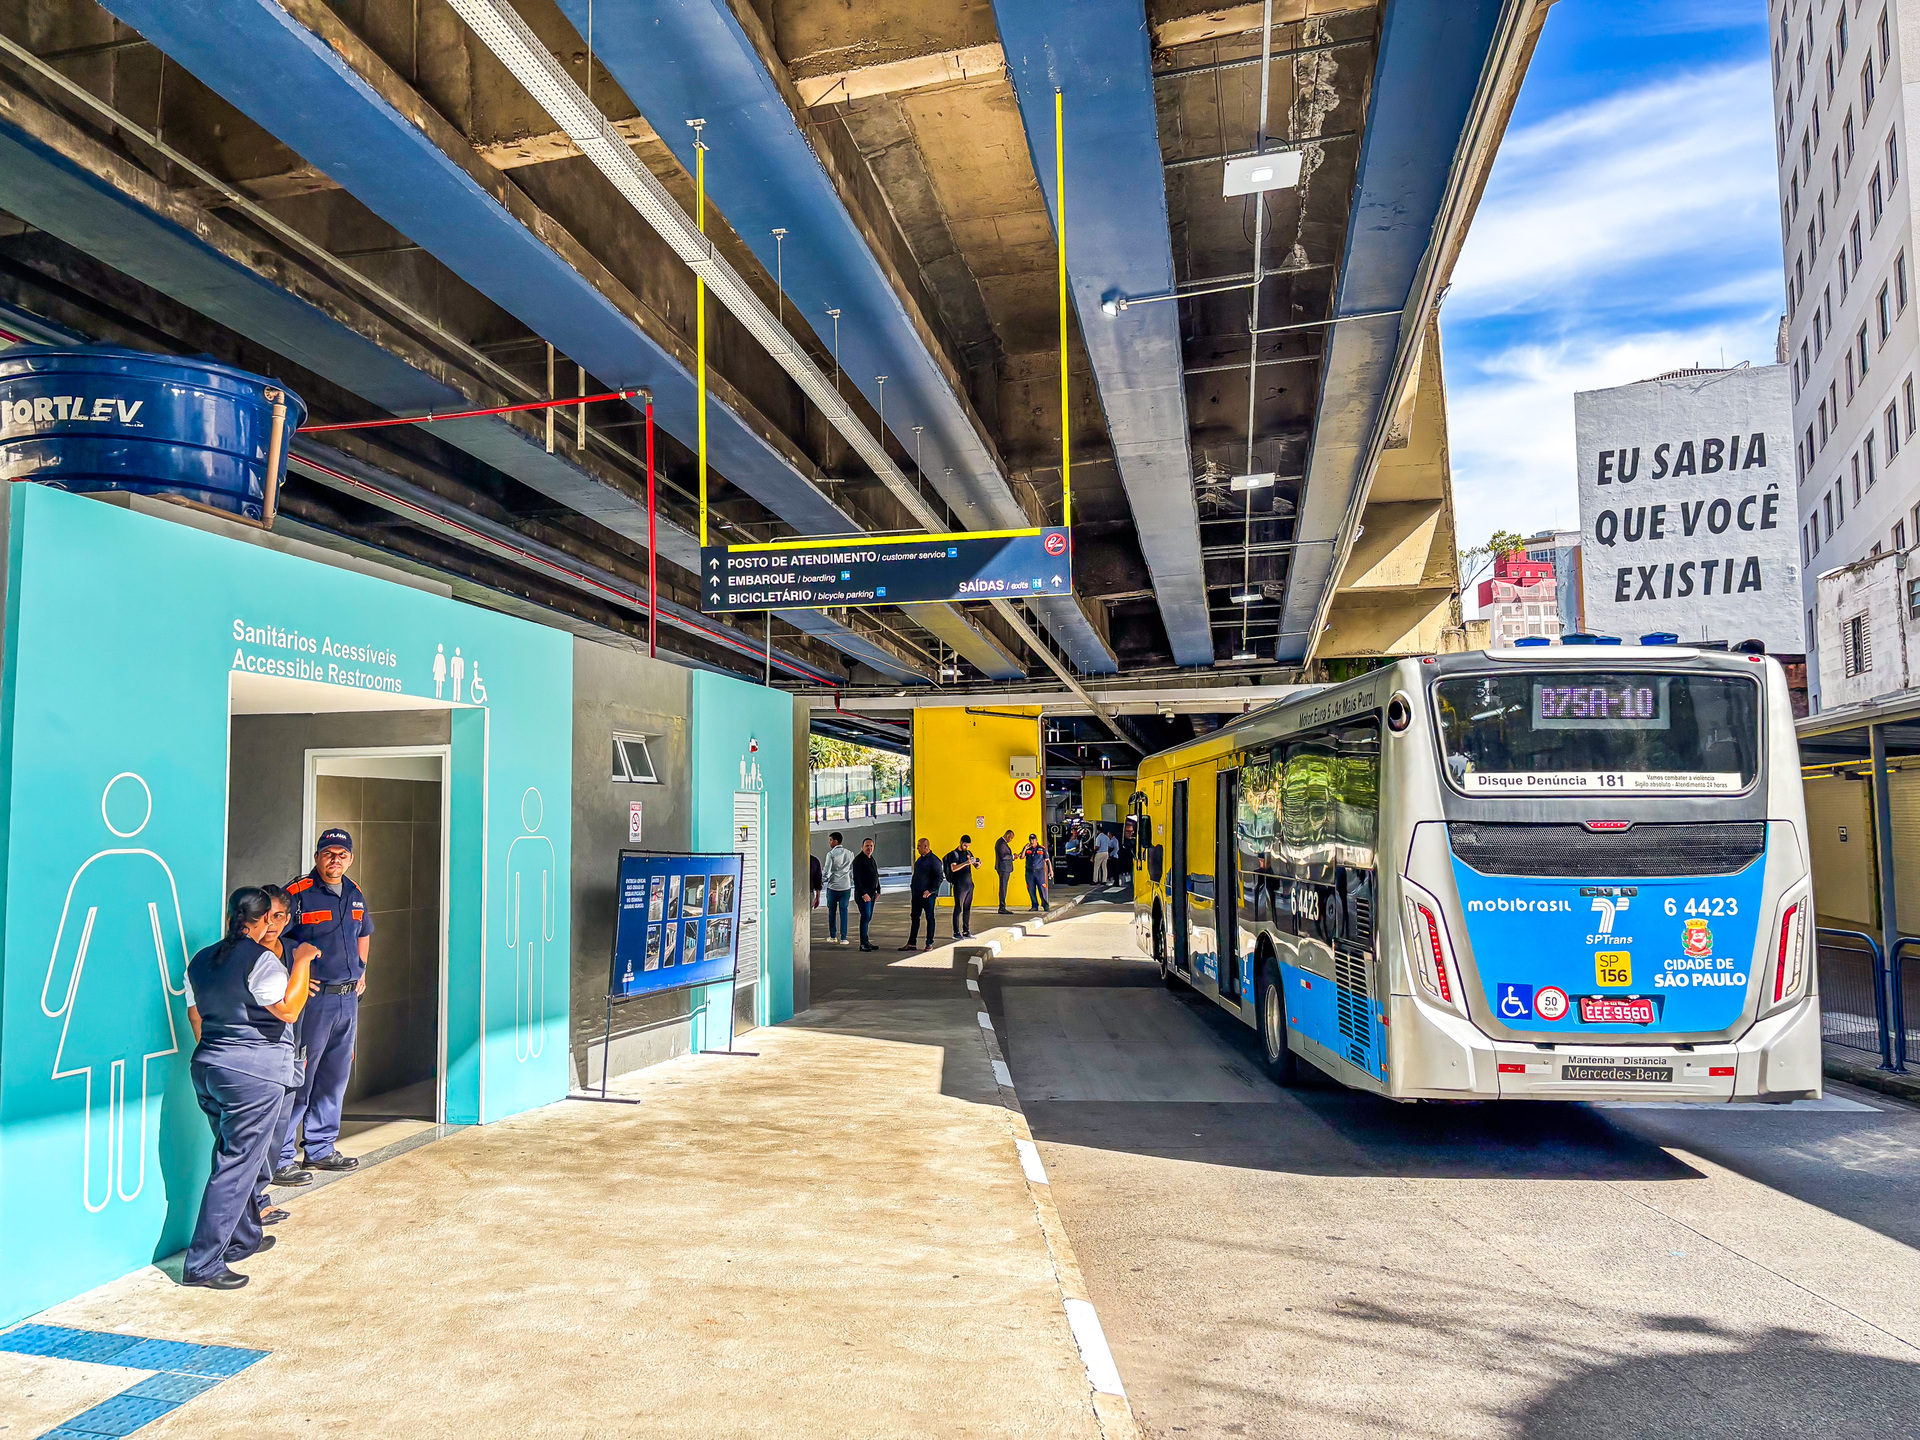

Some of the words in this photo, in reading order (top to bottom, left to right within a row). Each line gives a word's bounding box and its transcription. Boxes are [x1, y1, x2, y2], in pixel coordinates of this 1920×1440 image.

[1598, 447, 1640, 485] EU
[1651, 432, 1767, 480] SABIA
[1595, 504, 1666, 547] QUE
[1680, 482, 1779, 537] VOCÊ
[727, 556, 769, 569] POSTO
[771, 557, 788, 567] DE
[790, 551, 877, 566] ATENDIMENTO
[881, 551, 917, 561] customer
[918, 549, 946, 560] service
[728, 573, 796, 586] EMBARQUE
[802, 573, 836, 583] boarding
[958, 577, 1004, 593] SAÍDAS
[1010, 581, 1029, 590] exits
[1614, 556, 1762, 602] EXISTIA
[728, 588, 811, 604] BICICLETÁRIO
[817, 590, 845, 600] bicycle
[845, 589, 874, 600] parking
[232, 618, 317, 654] Sanitários
[321, 636, 397, 668] Acessíveis
[232, 648, 324, 681] Accessible
[328, 663, 402, 693] Restrooms
[1299, 712, 1313, 728] Motor
[1313, 707, 1326, 724] Euro
[1342, 695, 1356, 714] Mais
[1357, 691, 1373, 709] Puro
[1478, 775, 1523, 788] Disque
[1527, 775, 1587, 786] Denúncia
[1597, 774, 1624, 787] 181
[1693, 773, 1715, 781] violência
[1018, 783, 1031, 792] 10
[1291, 887, 1297, 916] 6
[1298, 888, 1320, 921] 4423
[1467, 897, 1572, 912] mobibrasil
[1664, 897, 1677, 917] 6
[1683, 897, 1739, 917] 4423
[1585, 934, 1634, 945] SPTrans
[1599, 954, 1619, 968] SP
[1663, 958, 1714, 971] CIDADE
[1716, 958, 1735, 970] DE
[1600, 969, 1628, 983] 156
[1654, 970, 1690, 988] SÃO
[1692, 972, 1747, 987] PAULO
[1544, 996, 1558, 1007] 50
[1568, 1055, 1615, 1065] Mantenha
[1623, 1056, 1667, 1066] Distância
[1567, 1066, 1668, 1081] Mercedes-Benz
